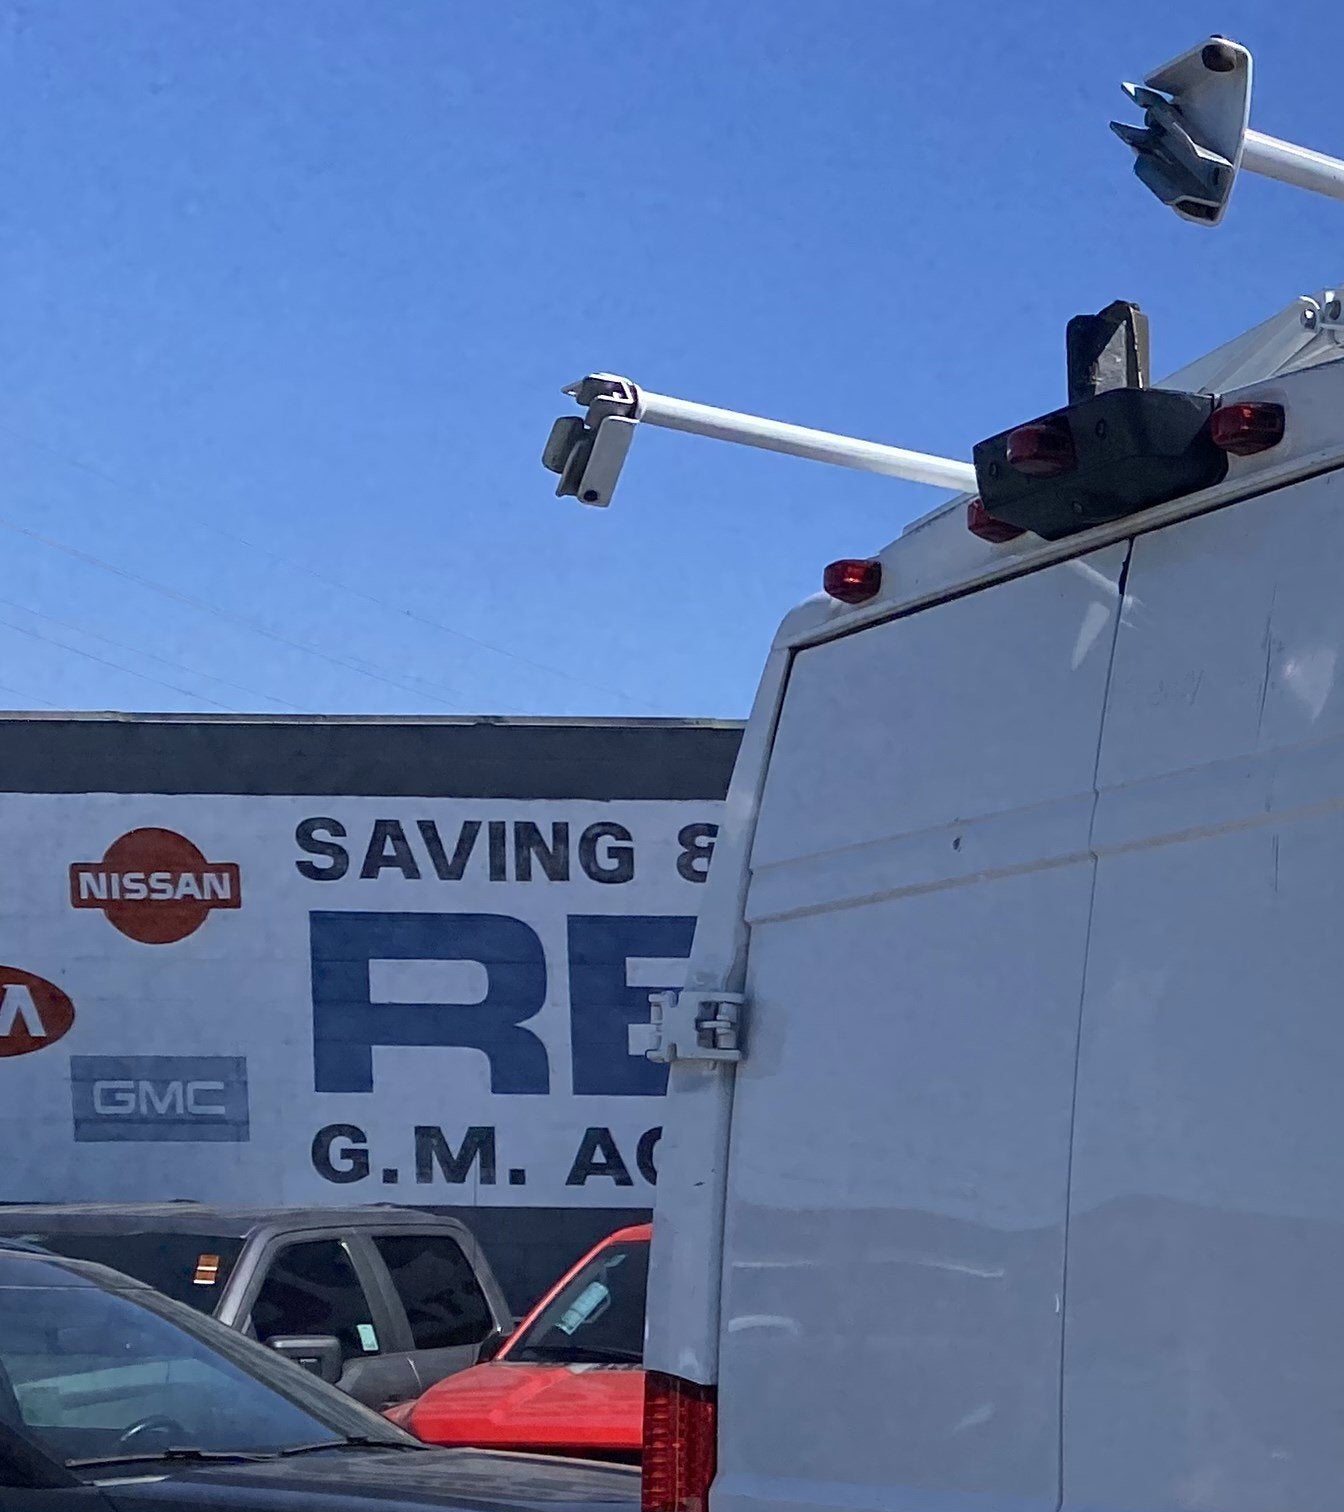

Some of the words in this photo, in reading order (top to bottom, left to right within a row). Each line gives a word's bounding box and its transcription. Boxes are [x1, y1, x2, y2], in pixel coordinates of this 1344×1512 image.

[294, 817, 636, 884] SAVING
[78, 870, 232, 901] NISSAN
[93, 1079, 228, 1116] GMC
[310, 1124, 528, 1186] G.M.
